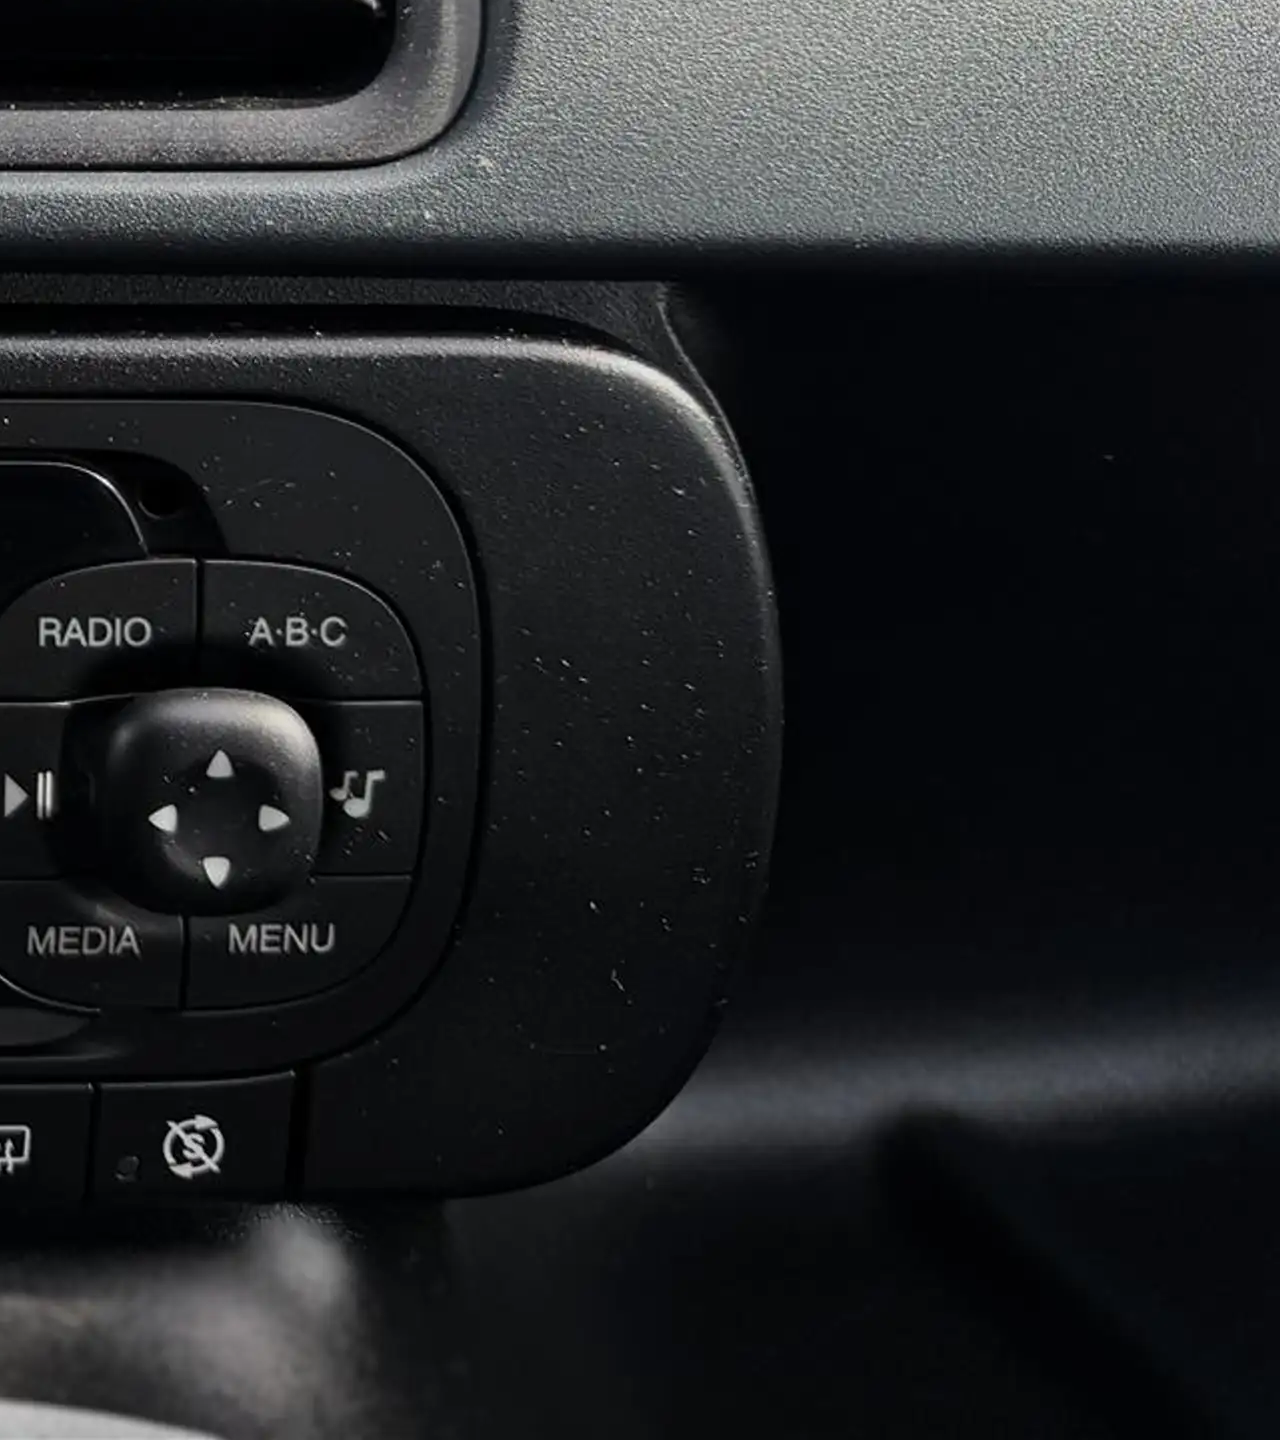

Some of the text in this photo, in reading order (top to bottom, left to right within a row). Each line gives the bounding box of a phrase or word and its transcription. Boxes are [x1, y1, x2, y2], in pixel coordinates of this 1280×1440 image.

[38, 616, 153, 648] RADIO
[26, 926, 141, 956] MEDIA
[228, 923, 336, 953] MENU
